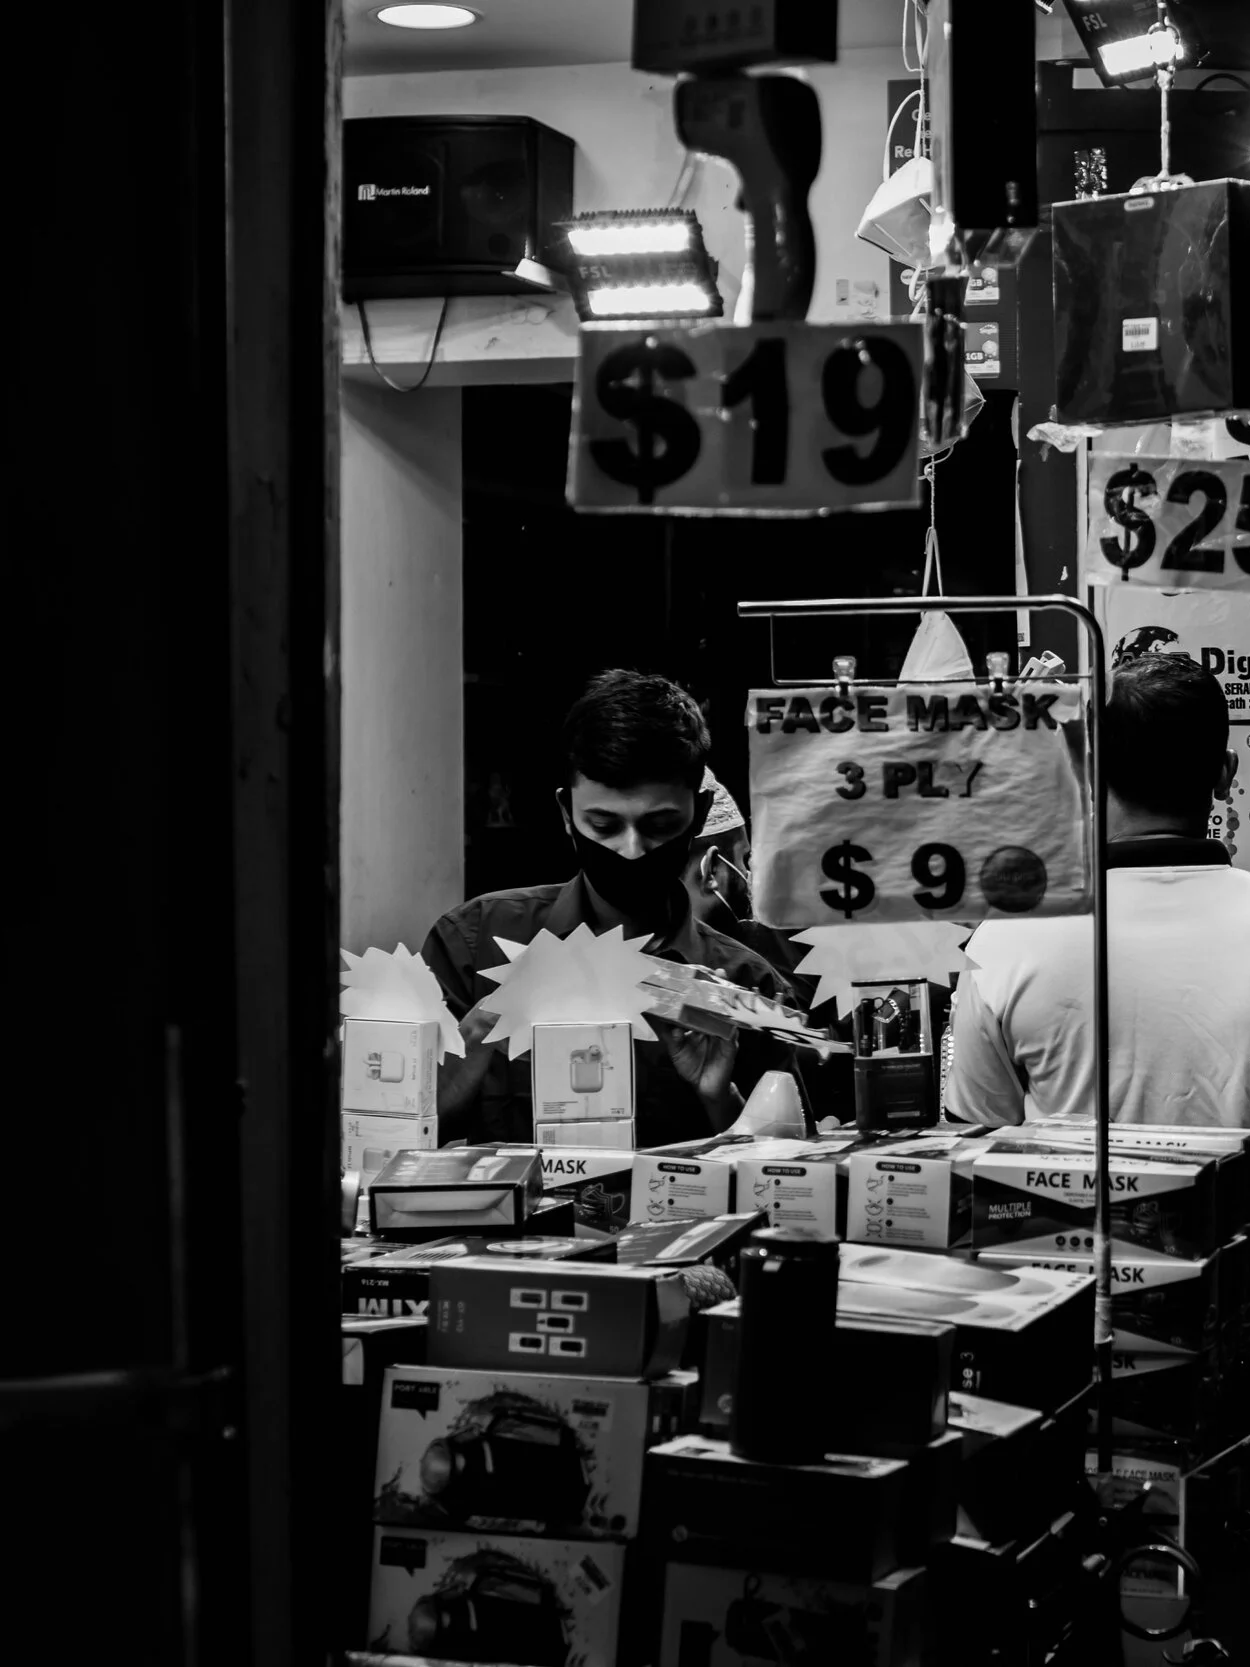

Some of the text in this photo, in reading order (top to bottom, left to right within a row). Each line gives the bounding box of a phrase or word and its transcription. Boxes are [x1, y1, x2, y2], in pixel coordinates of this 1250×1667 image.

[1082, 12, 1108, 33] FSL
[376, 185, 430, 196] Martin Roland
[590, 334, 917, 505] $19
[1227, 696, 1246, 709] ath
[756, 692, 1061, 735] FACE MASK
[835, 760, 984, 801] 3 PLY
[541, 1159, 587, 1175] MASK
[1026, 1171, 1071, 1188] FACE
[988, 1211, 1032, 1220] PROTECTION
[989, 1202, 1032, 1214] MULTIPLE
